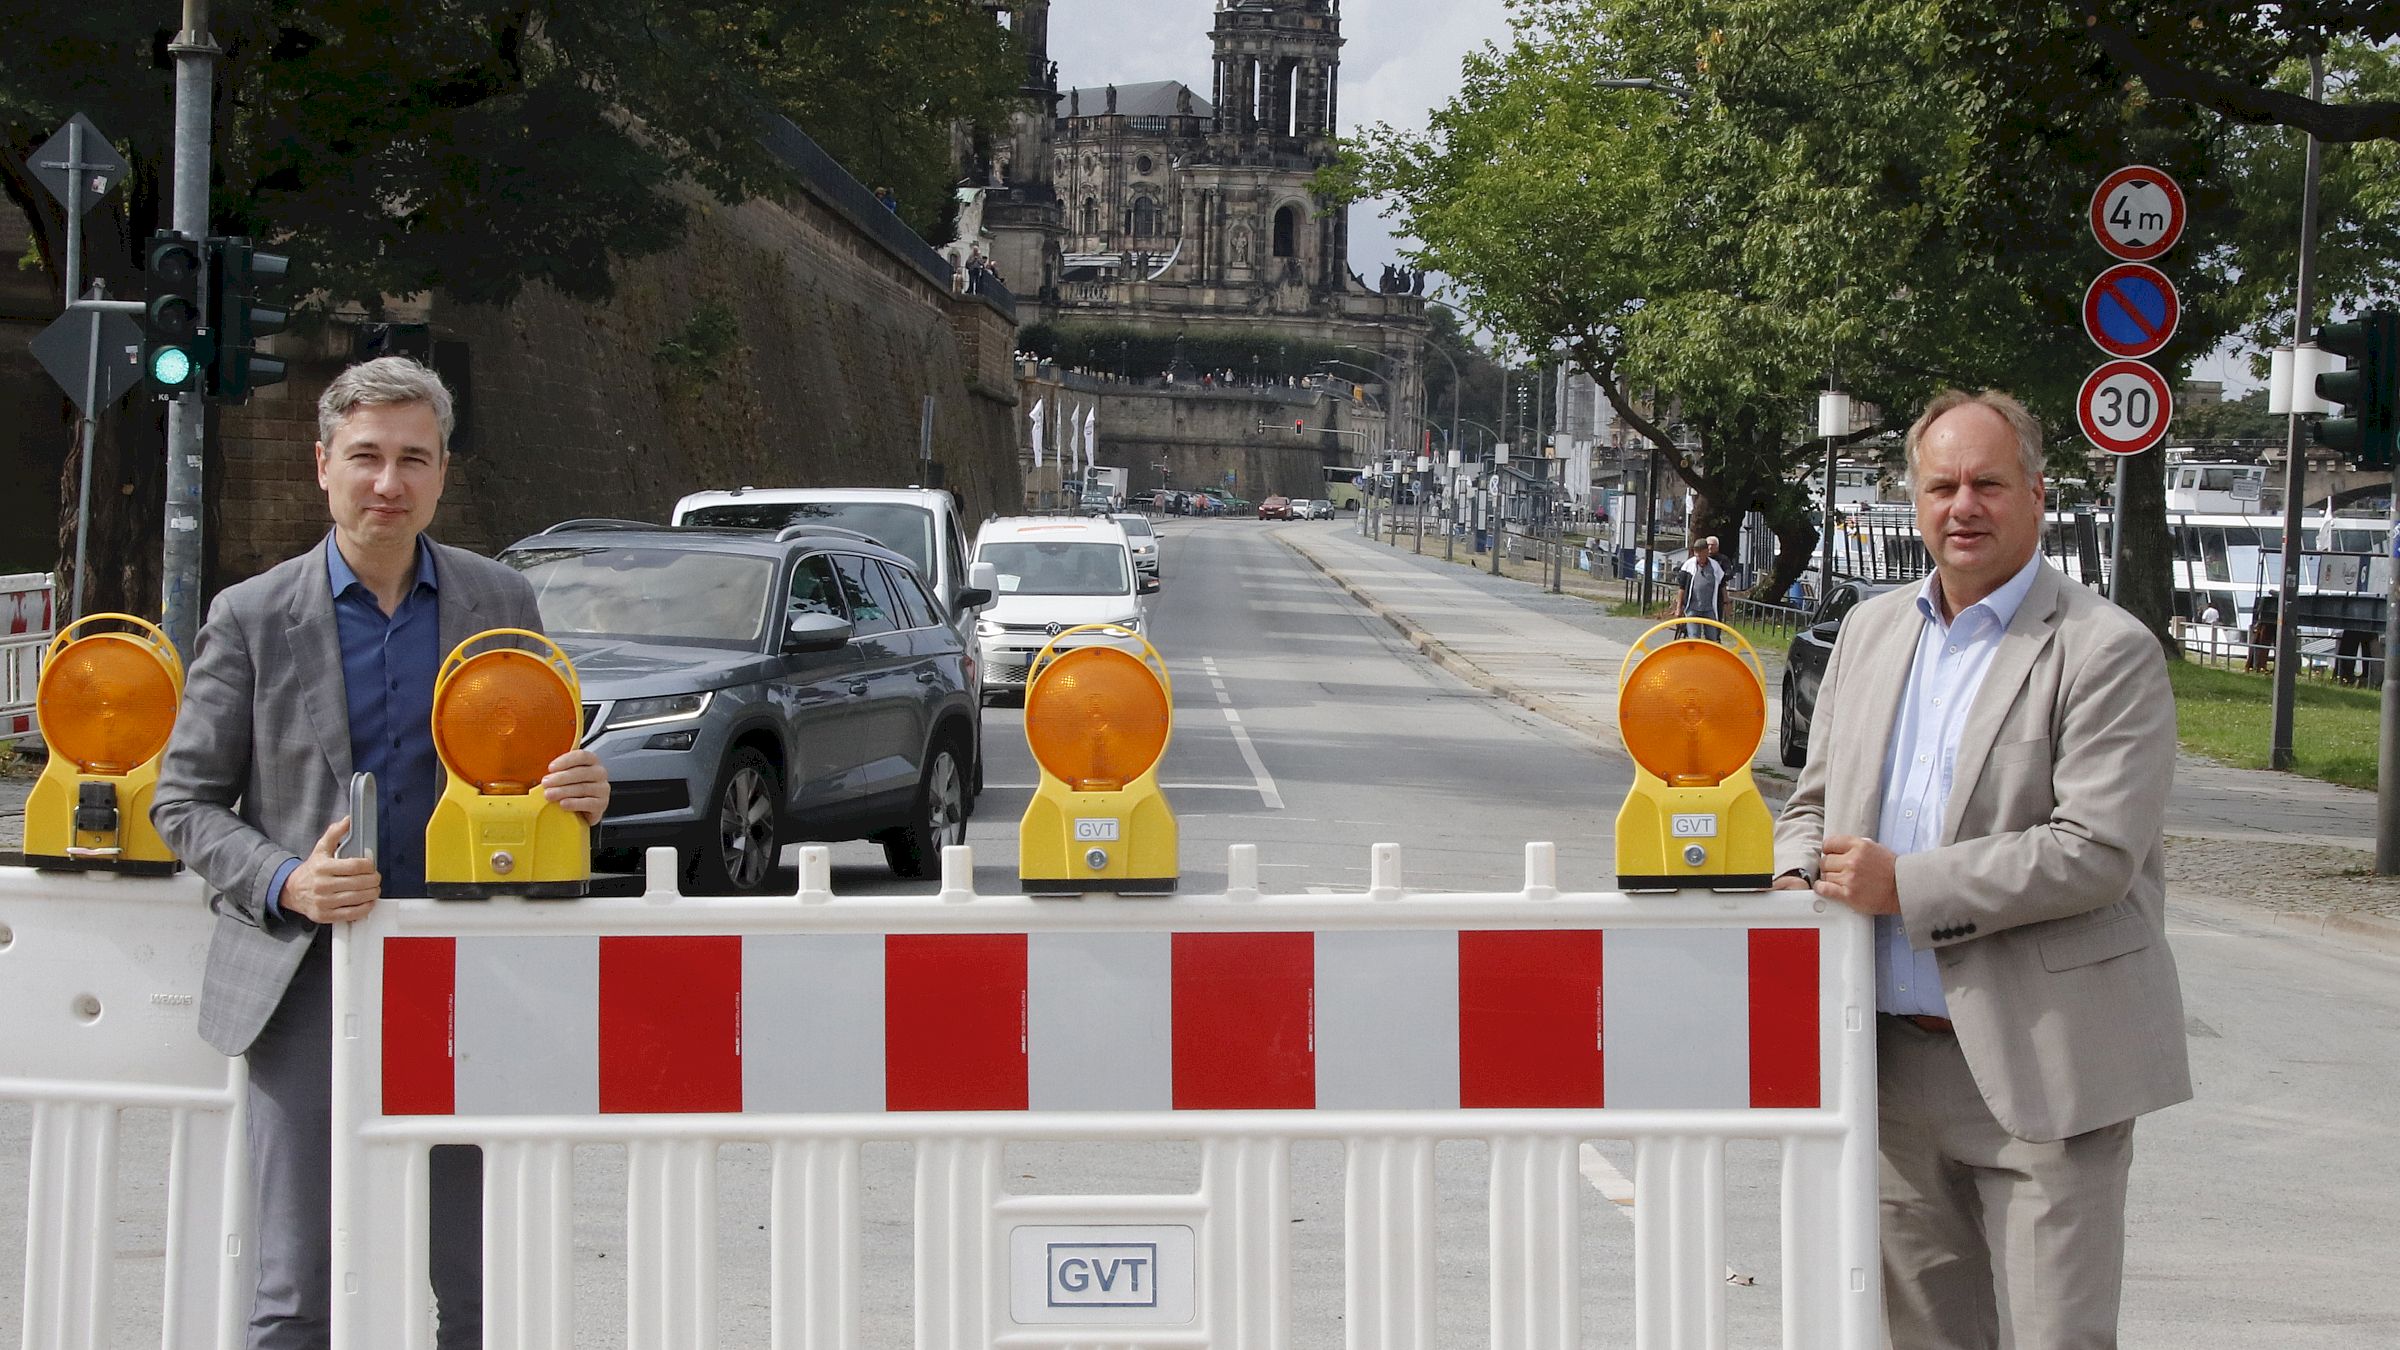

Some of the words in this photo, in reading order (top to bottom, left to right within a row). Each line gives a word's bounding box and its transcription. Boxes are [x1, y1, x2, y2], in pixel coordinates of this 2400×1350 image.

[2110, 196, 2131, 229] 4
[2139, 212, 2163, 229] m
[2098, 387, 2150, 428] 30
[1079, 823, 1115, 837] GVT
[1676, 818, 1712, 833] GVT
[1058, 1258, 1147, 1292] GVT
